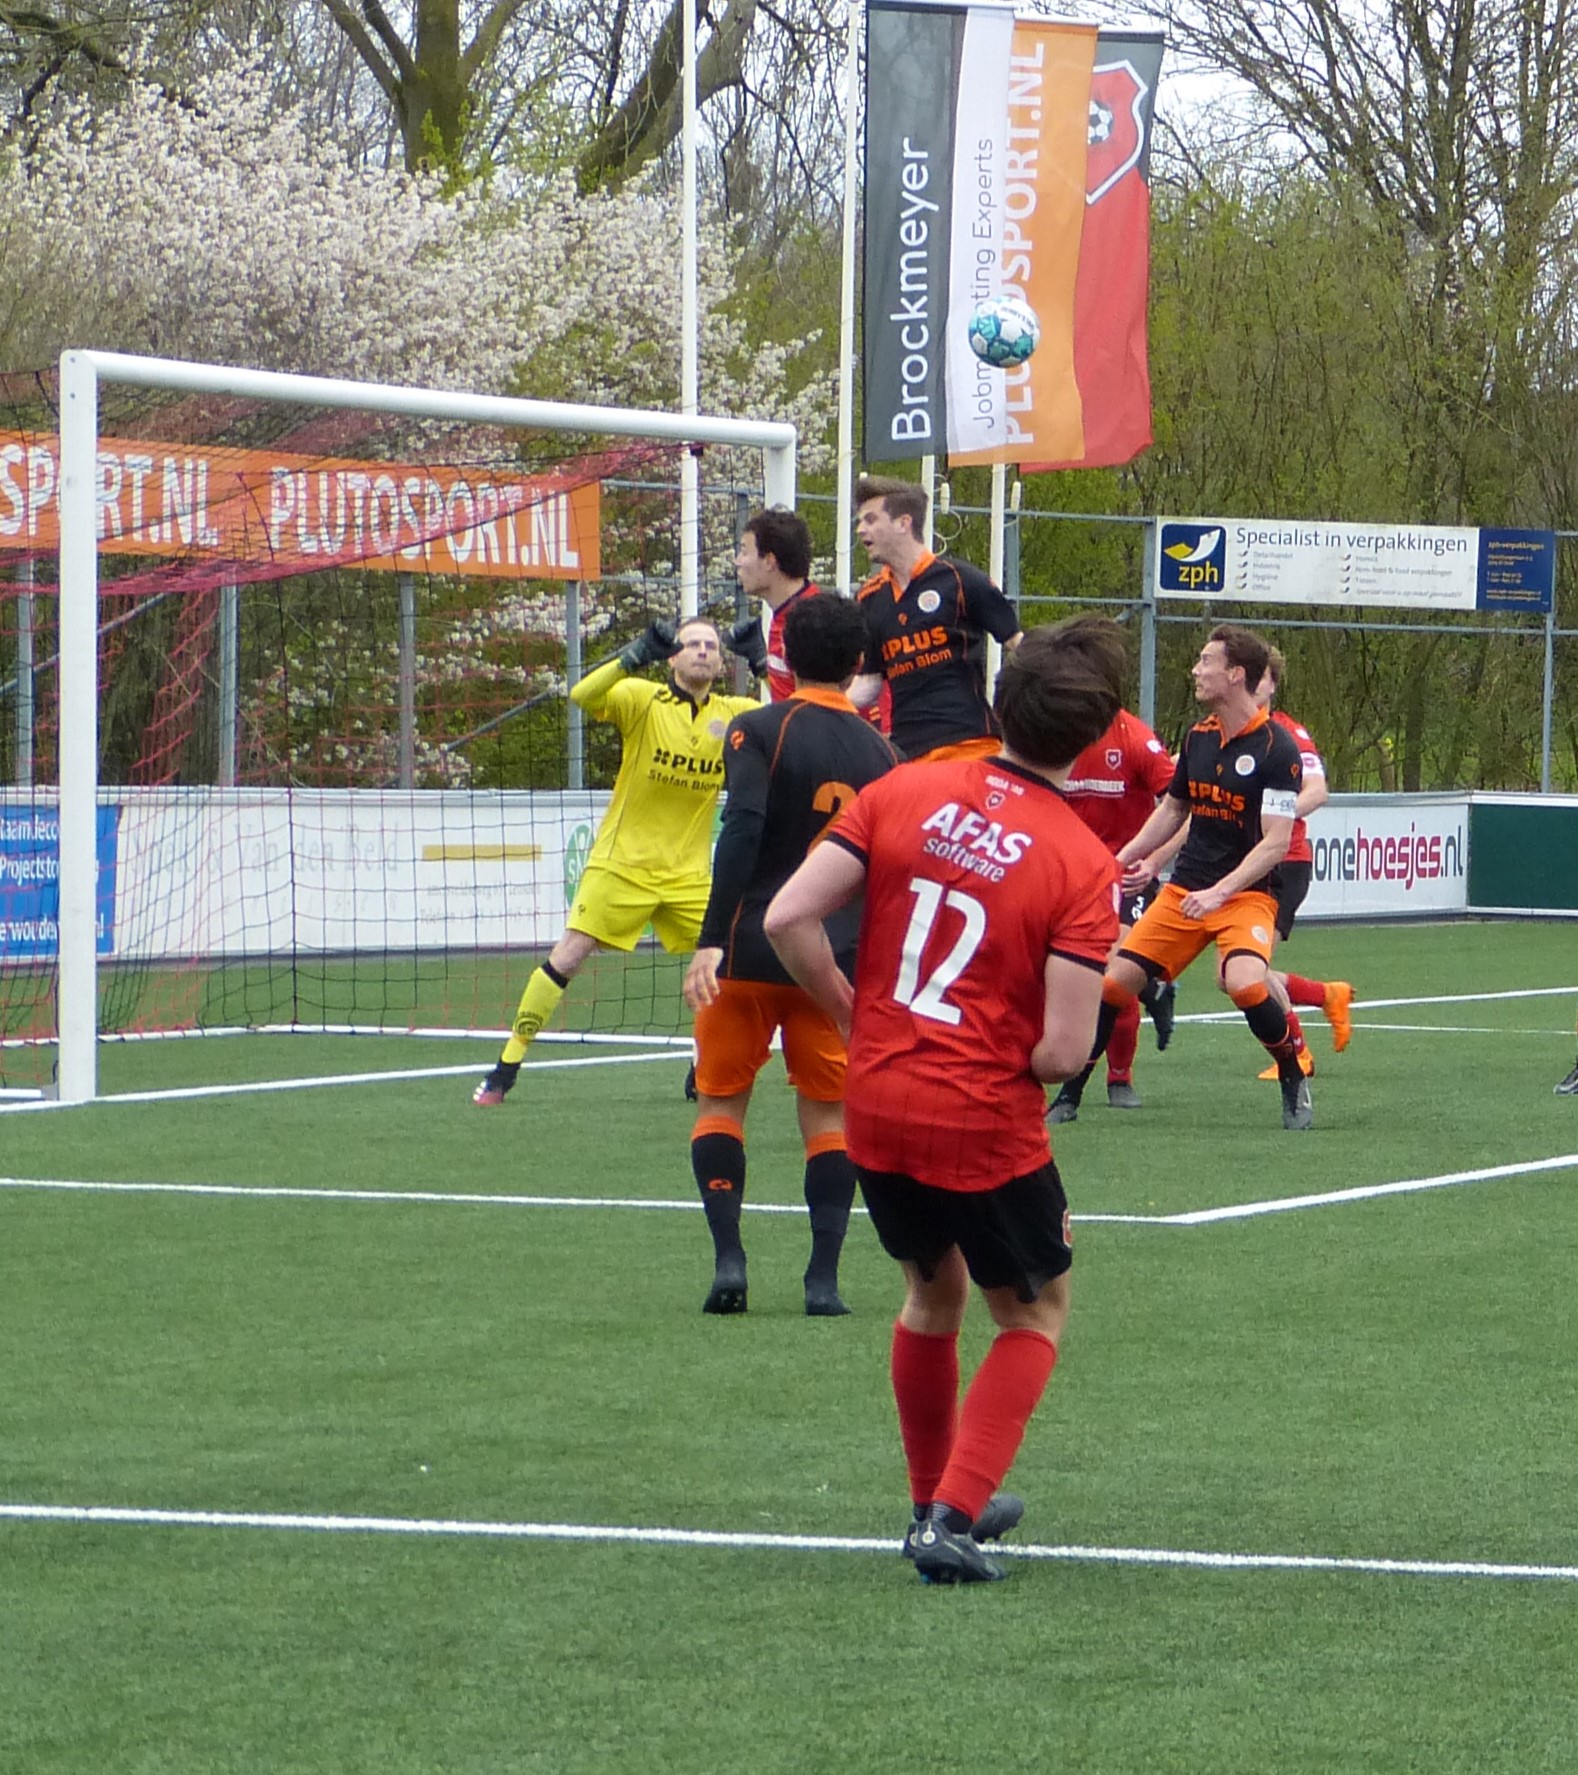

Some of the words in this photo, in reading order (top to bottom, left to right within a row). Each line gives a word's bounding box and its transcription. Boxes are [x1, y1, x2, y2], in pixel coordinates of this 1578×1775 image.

[972, 138, 997, 239] Experts
[1002, 43, 1045, 443] PLUSPORT.NL
[891, 137, 940, 441] Brockmeyer
[971, 248, 996, 429] Jobmting
[0, 444, 218, 546] SPRT.NL
[270, 466, 579, 568] PLUTOSPORT.NL
[1236, 527, 1320, 548] Specialist
[1325, 531, 1341, 547] in
[1347, 533, 1468, 555] verpakkingen
[1178, 560, 1219, 589] zph
[886, 626, 948, 659] PLUS
[916, 648, 952, 668] Blom
[648, 769, 688, 788] Stefan
[671, 753, 723, 775] PLUS
[1199, 782, 1245, 812] PLUS
[921, 802, 1033, 864] AFAS
[923, 837, 1006, 883] software
[893, 876, 987, 1026] 12
